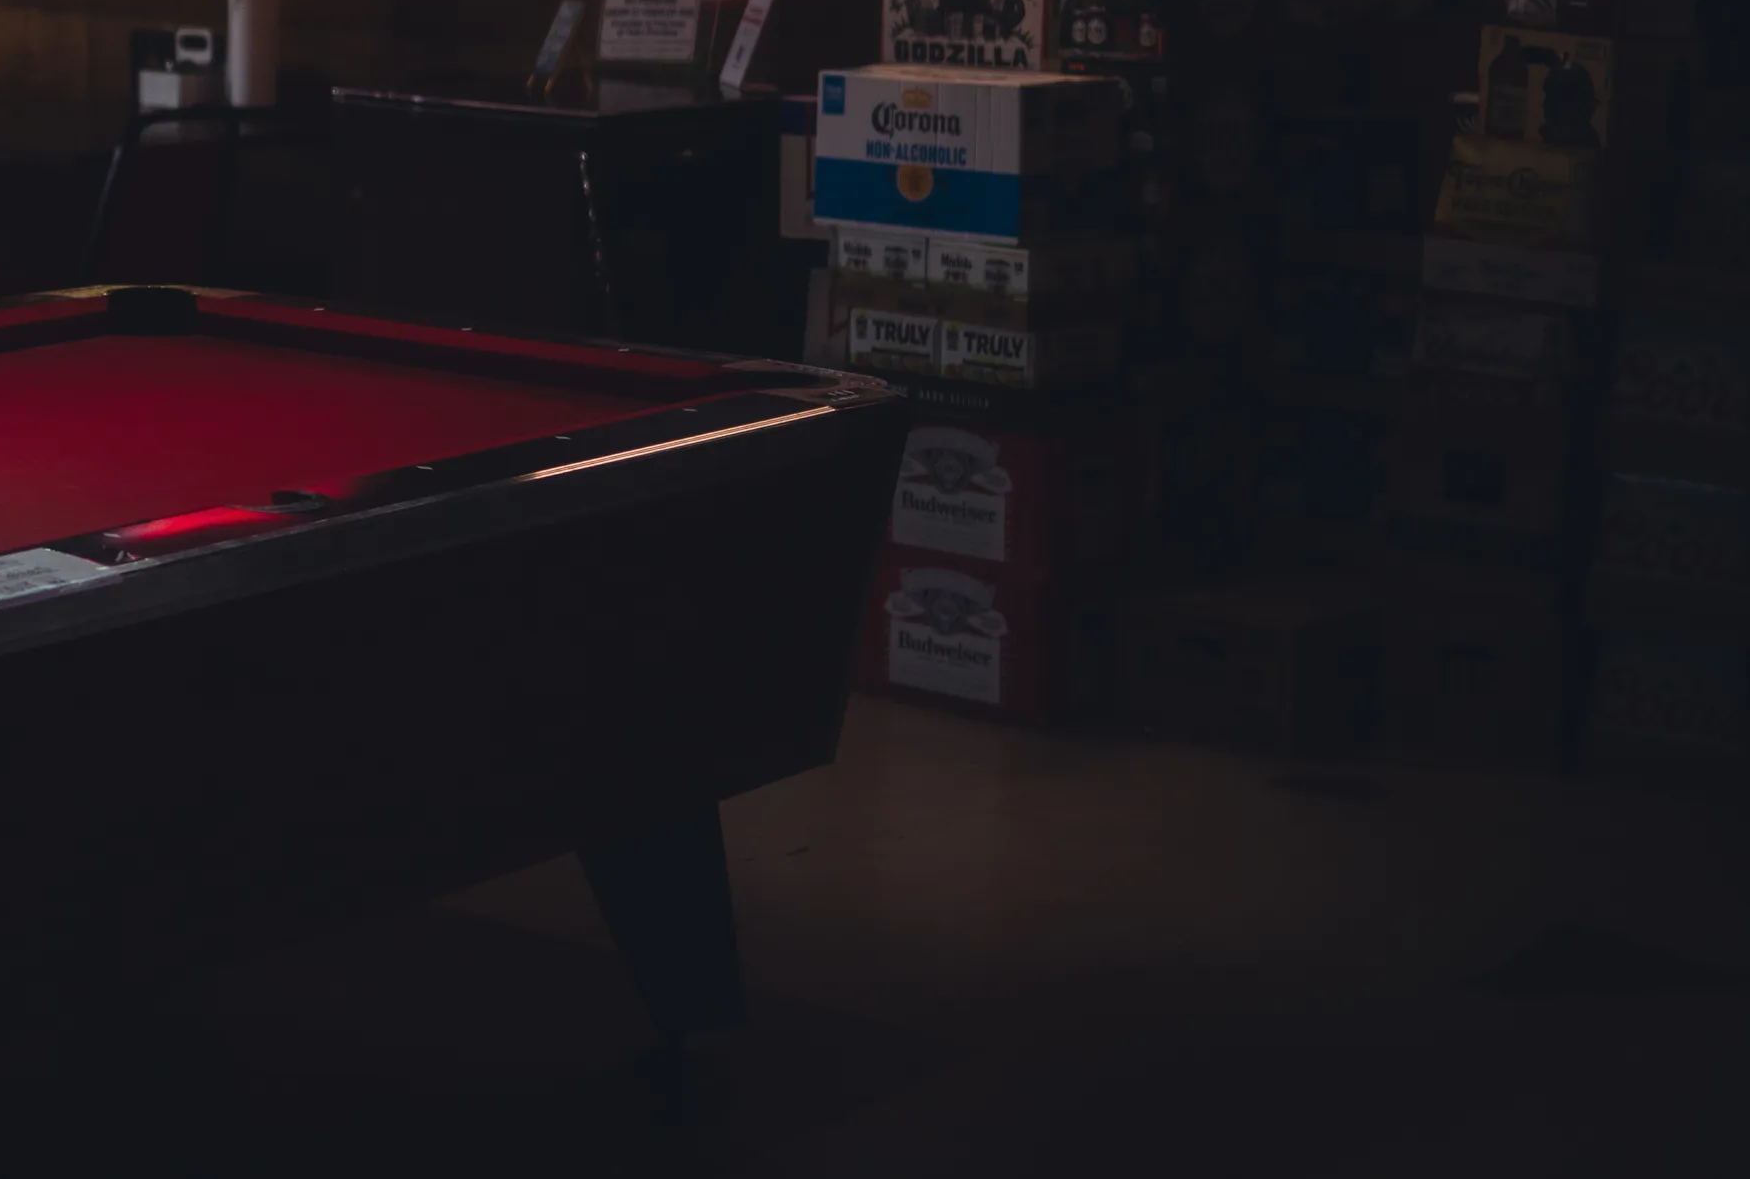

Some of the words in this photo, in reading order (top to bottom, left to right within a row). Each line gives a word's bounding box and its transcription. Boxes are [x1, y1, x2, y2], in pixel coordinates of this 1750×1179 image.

[870, 100, 962, 139] Corona
[865, 138, 967, 166] NON-ALCOHOLIC
[872, 319, 931, 347] TRULY
[964, 330, 1025, 359] TRULY
[901, 489, 997, 524] Budweiser
[897, 629, 992, 667] Budweiser
